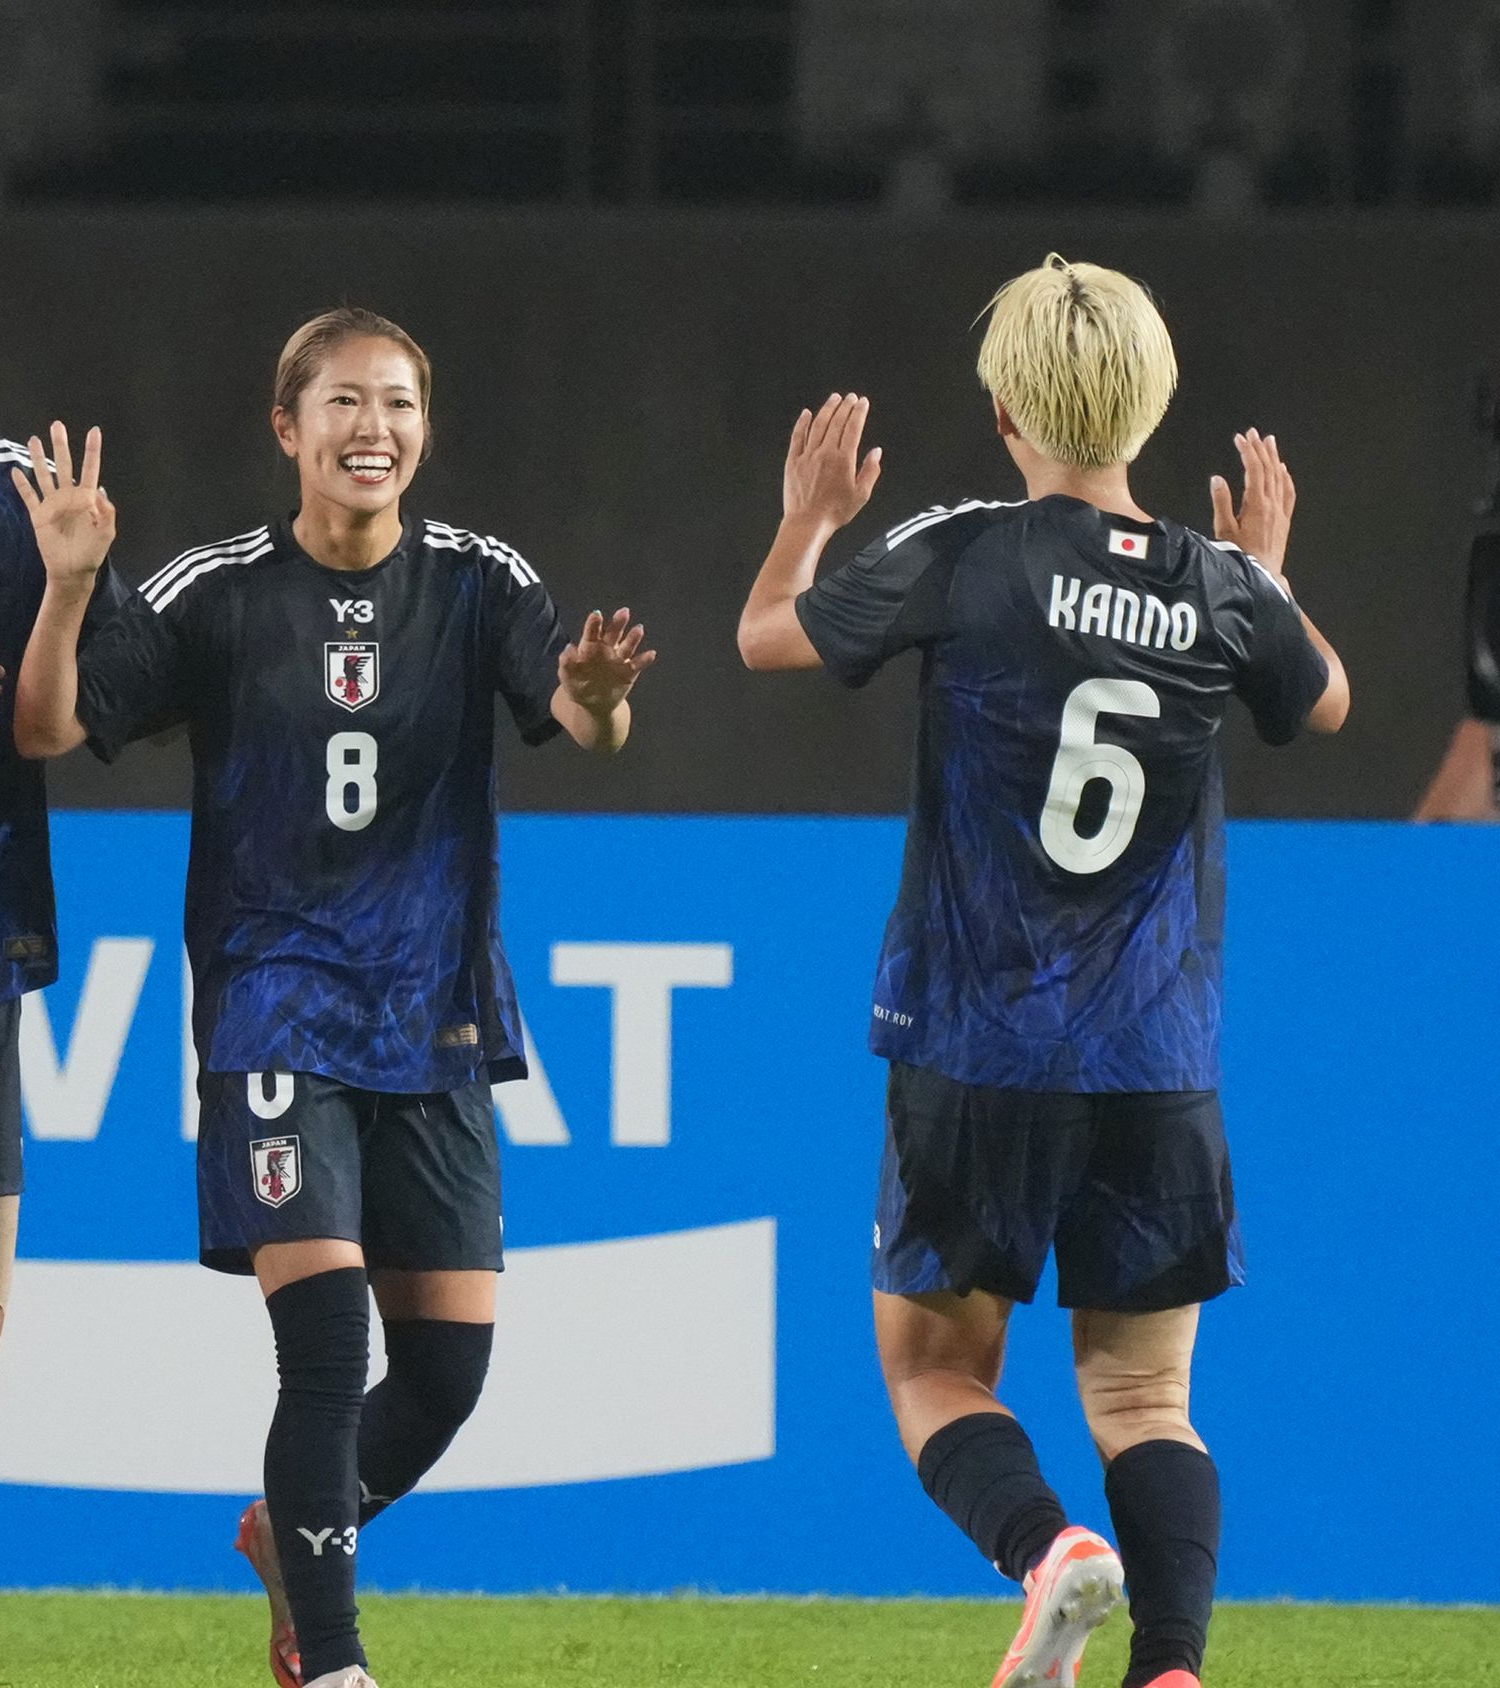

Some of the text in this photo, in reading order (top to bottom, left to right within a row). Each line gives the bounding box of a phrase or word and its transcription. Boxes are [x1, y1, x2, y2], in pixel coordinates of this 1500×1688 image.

[329, 598, 374, 623] Y-3
[1049, 573, 1198, 652] KANNO
[325, 731, 378, 832] 8
[1039, 678, 1161, 874] 6
[261, 1139, 287, 1149] JAPAN
[297, 1526, 358, 1557] Y-3
